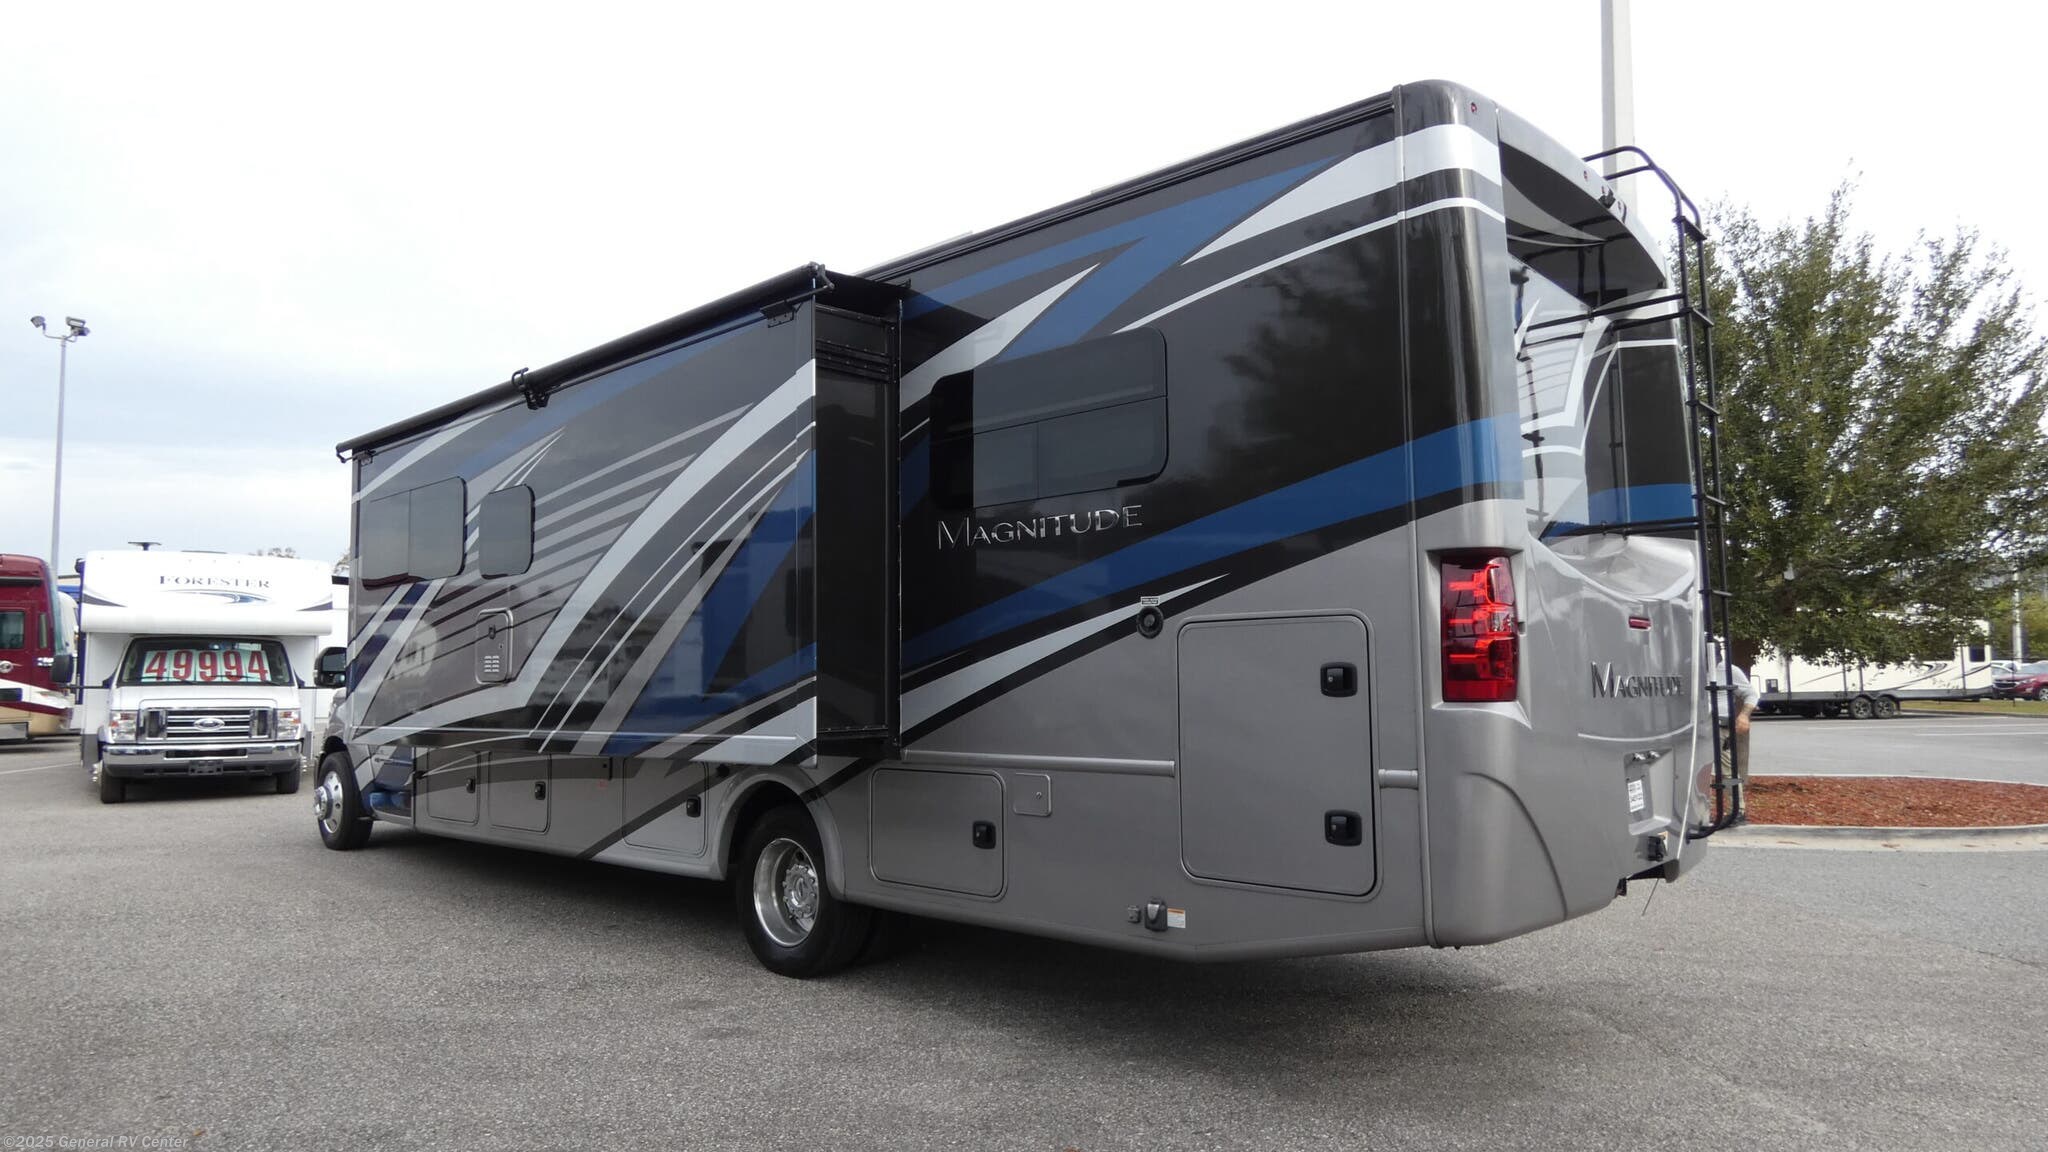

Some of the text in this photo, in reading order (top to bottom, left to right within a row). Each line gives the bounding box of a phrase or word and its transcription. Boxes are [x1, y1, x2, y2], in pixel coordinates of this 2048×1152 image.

[937, 504, 1143, 550] MAGNITUDE
[159, 575, 270, 588] FORESTER
[145, 649, 269, 682] 49994
[1590, 661, 1685, 698] MAGNITUDE
